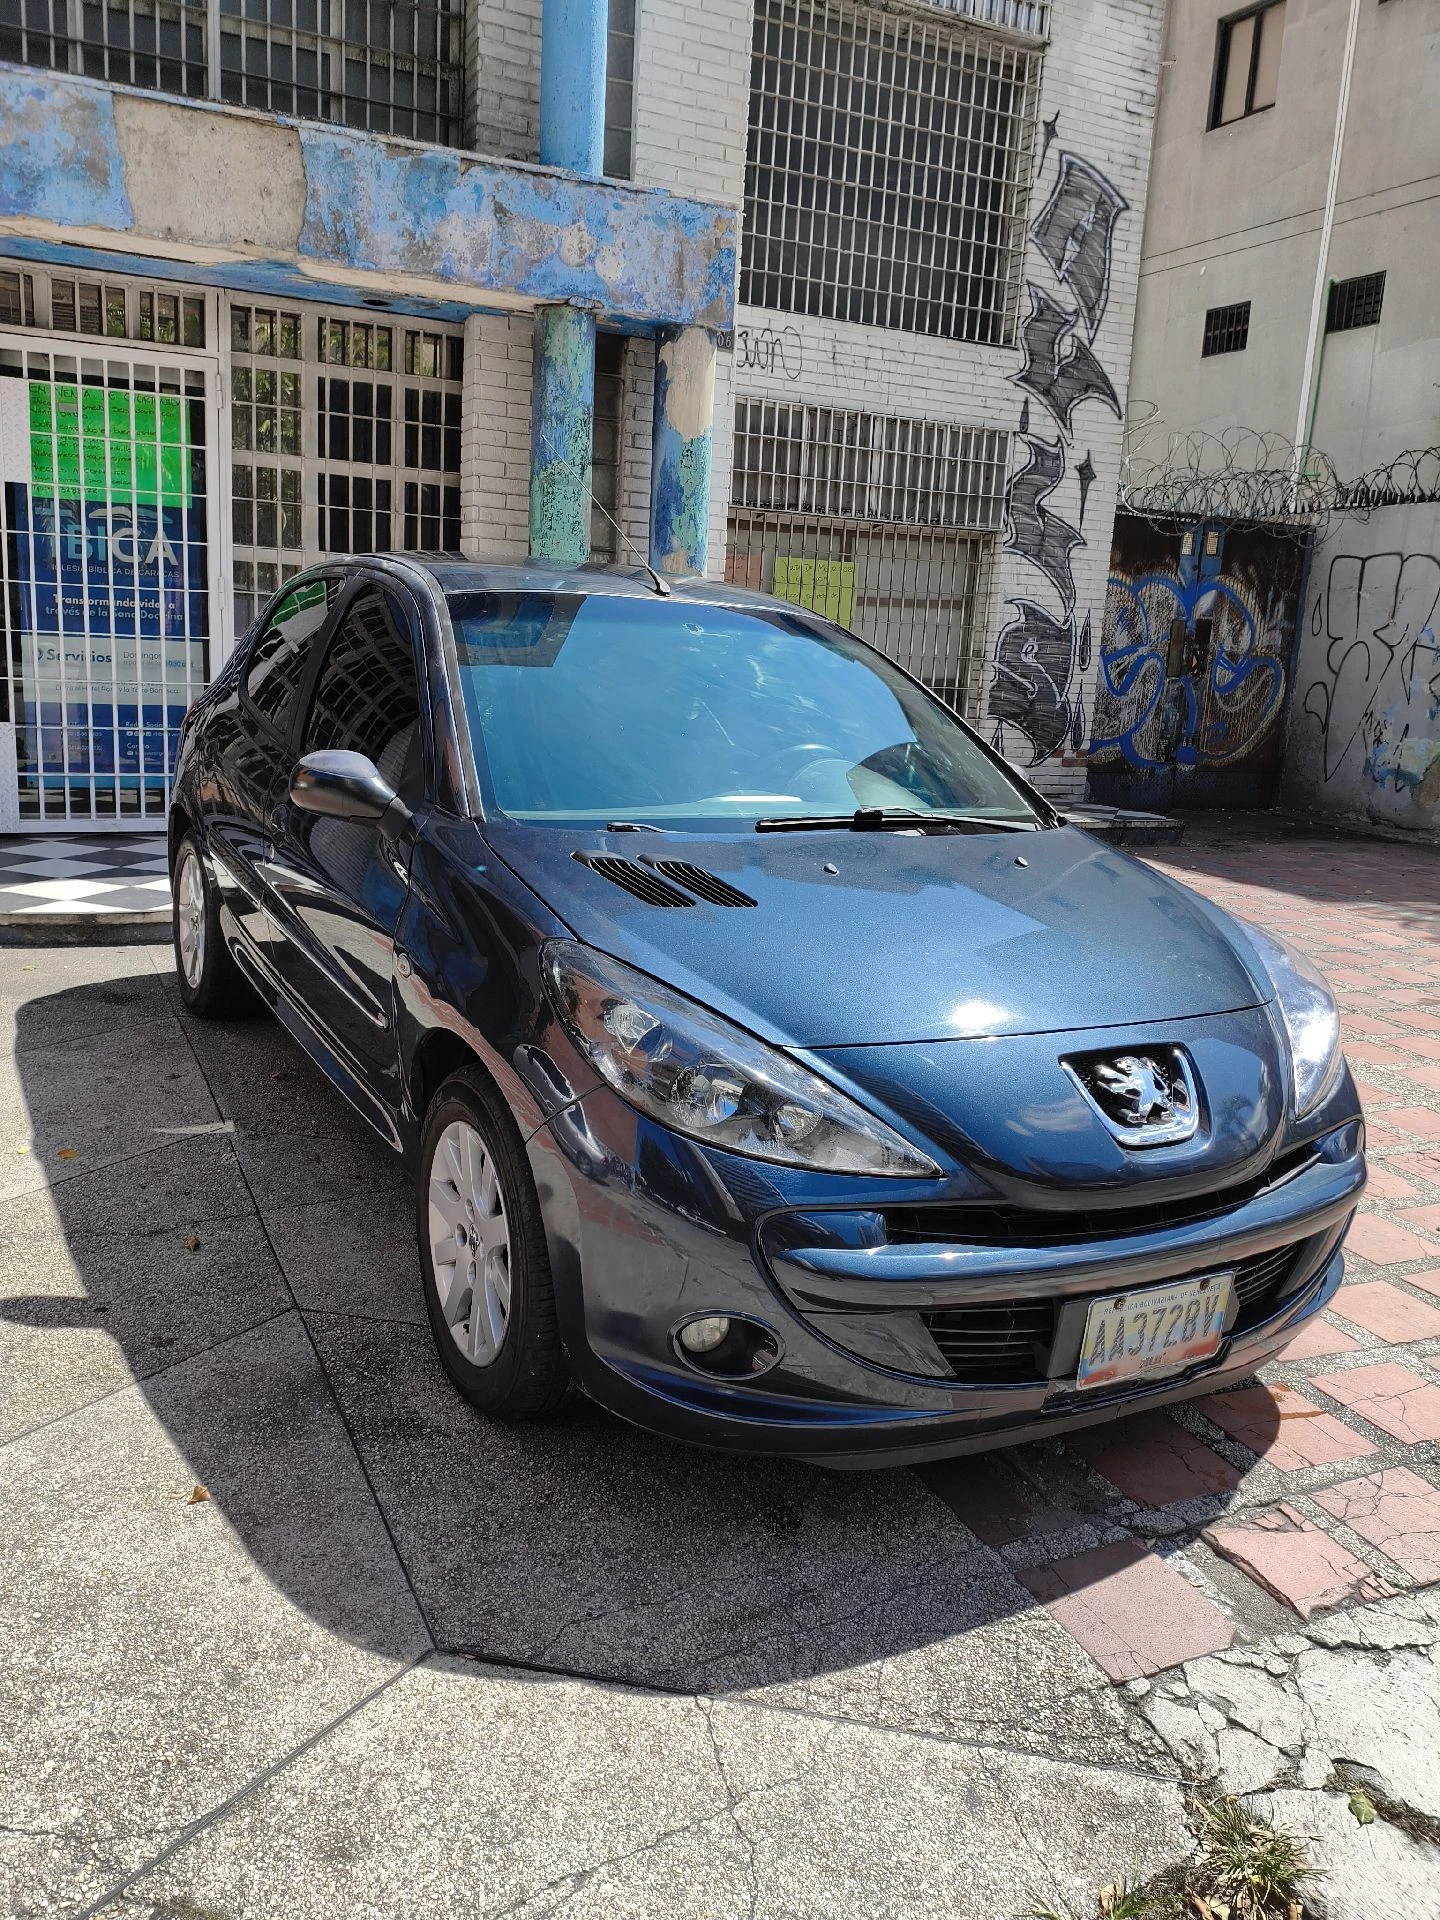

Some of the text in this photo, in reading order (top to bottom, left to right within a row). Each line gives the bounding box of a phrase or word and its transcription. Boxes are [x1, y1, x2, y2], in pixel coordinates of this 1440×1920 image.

[55, 386, 91, 399] VENA
[98, 608, 109, 618] la
[1088, 1294, 1220, 1367] AA372BV
